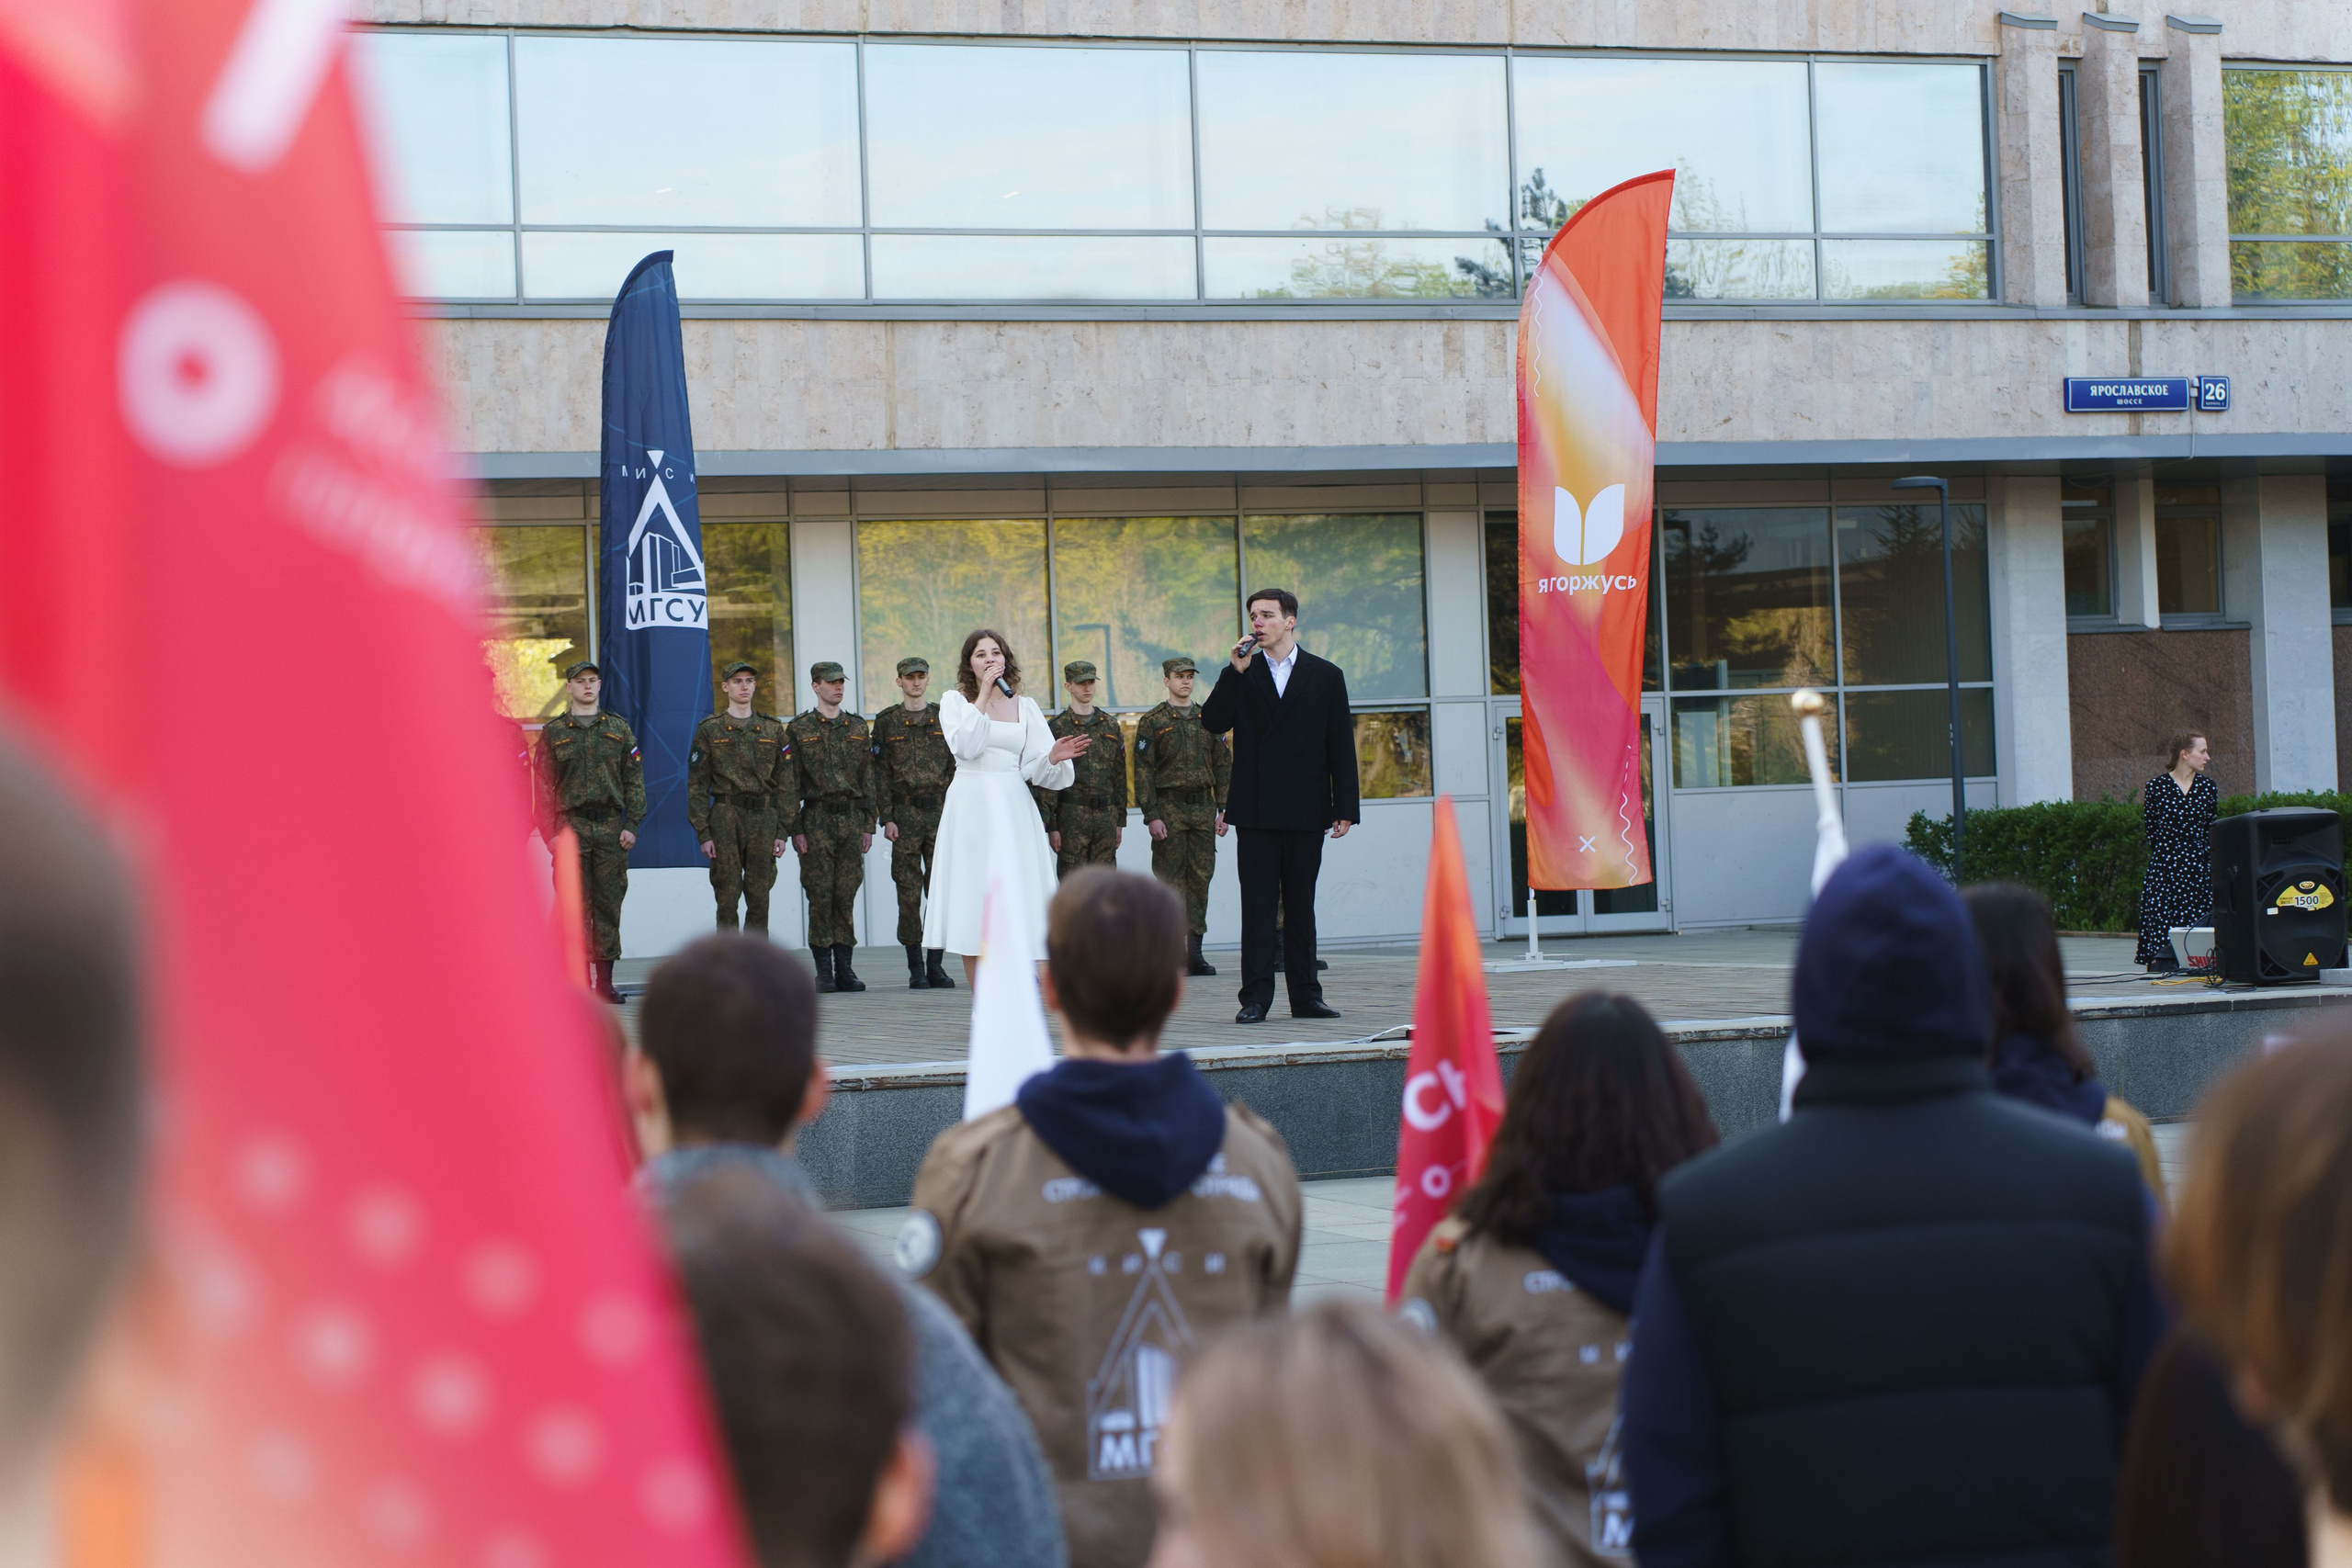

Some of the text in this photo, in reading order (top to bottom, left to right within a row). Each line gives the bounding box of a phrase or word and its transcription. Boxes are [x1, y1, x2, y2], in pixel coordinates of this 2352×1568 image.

[2089, 384, 2169, 397] ЯРОСЛАВСКОЕ
[2204, 382, 2226, 401] 26
[628, 598, 706, 625] МГСУ
[2294, 895, 2320, 906] 1500
